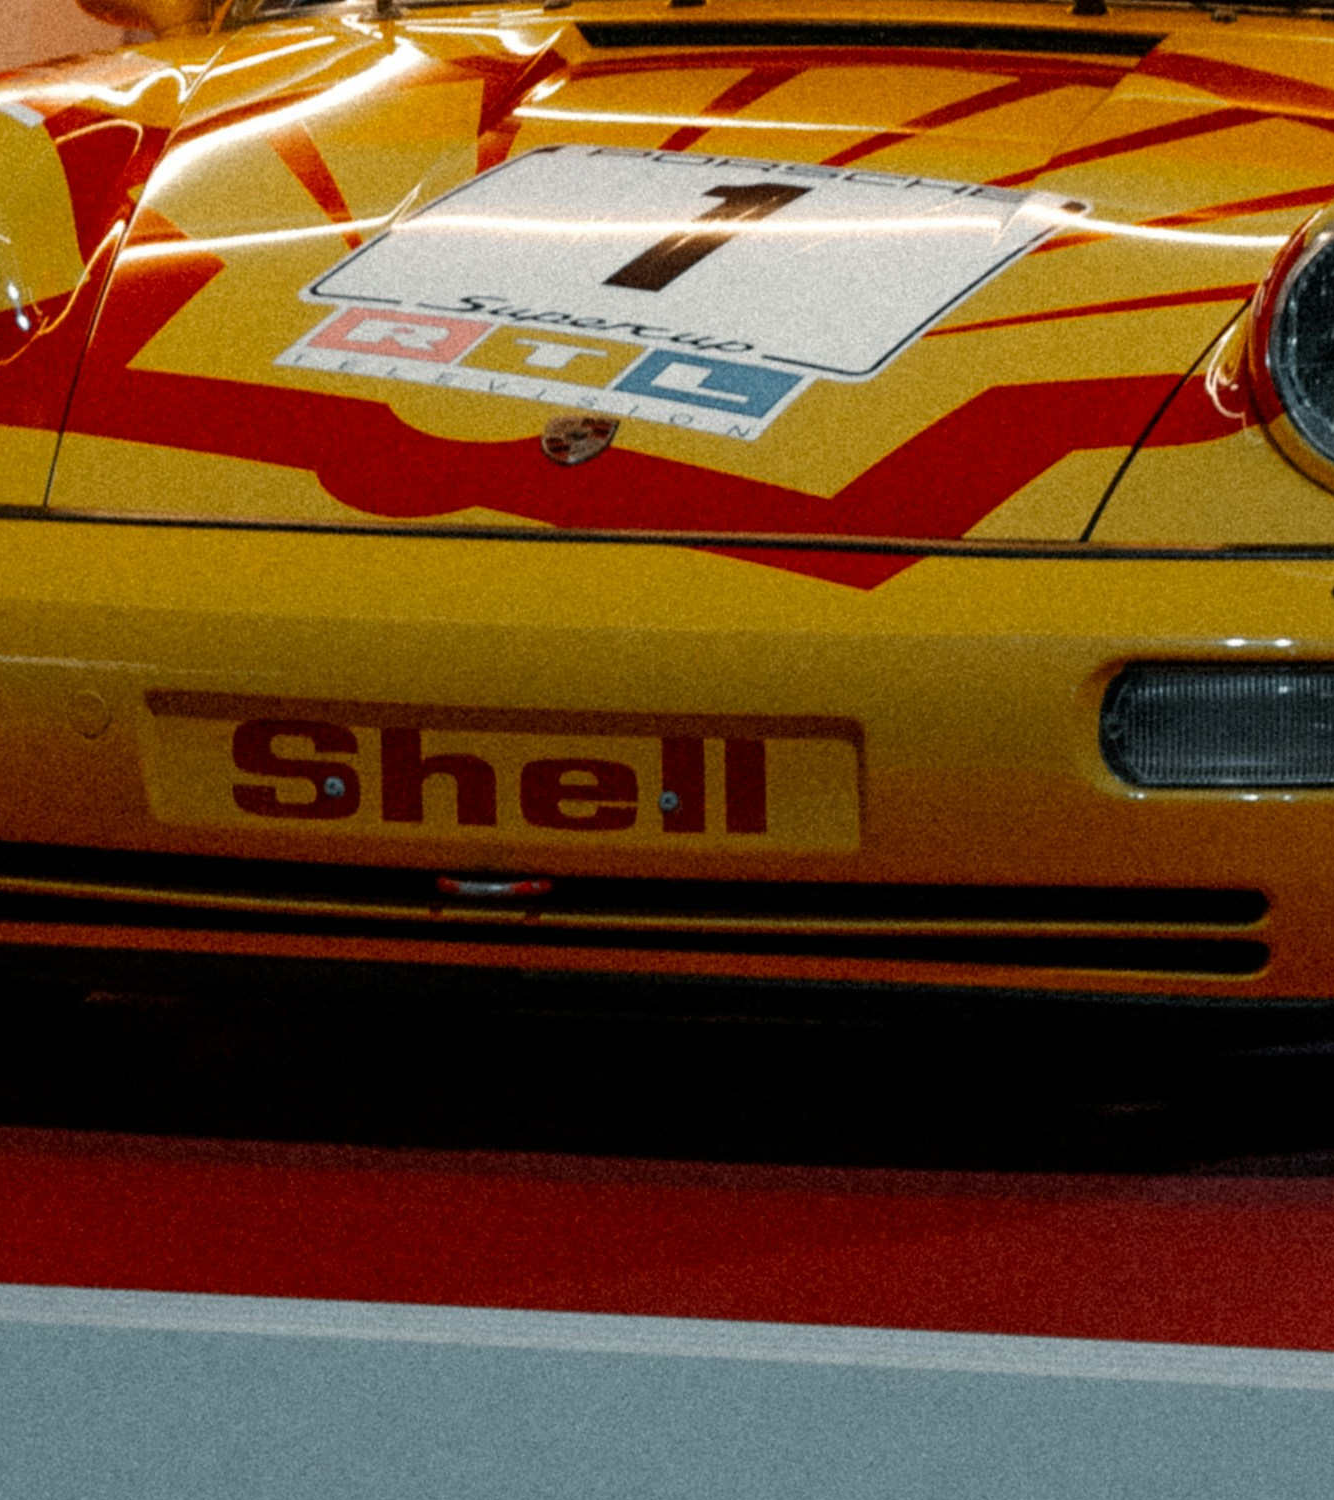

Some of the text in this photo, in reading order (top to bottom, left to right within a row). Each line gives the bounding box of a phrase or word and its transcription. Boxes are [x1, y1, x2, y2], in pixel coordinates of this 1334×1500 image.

[602, 181, 816, 292] 1
[345, 317, 751, 405] RTL
[419, 295, 755, 354] Supercup
[292, 352, 751, 440] TELEVISION
[231, 716, 768, 834] Shell
